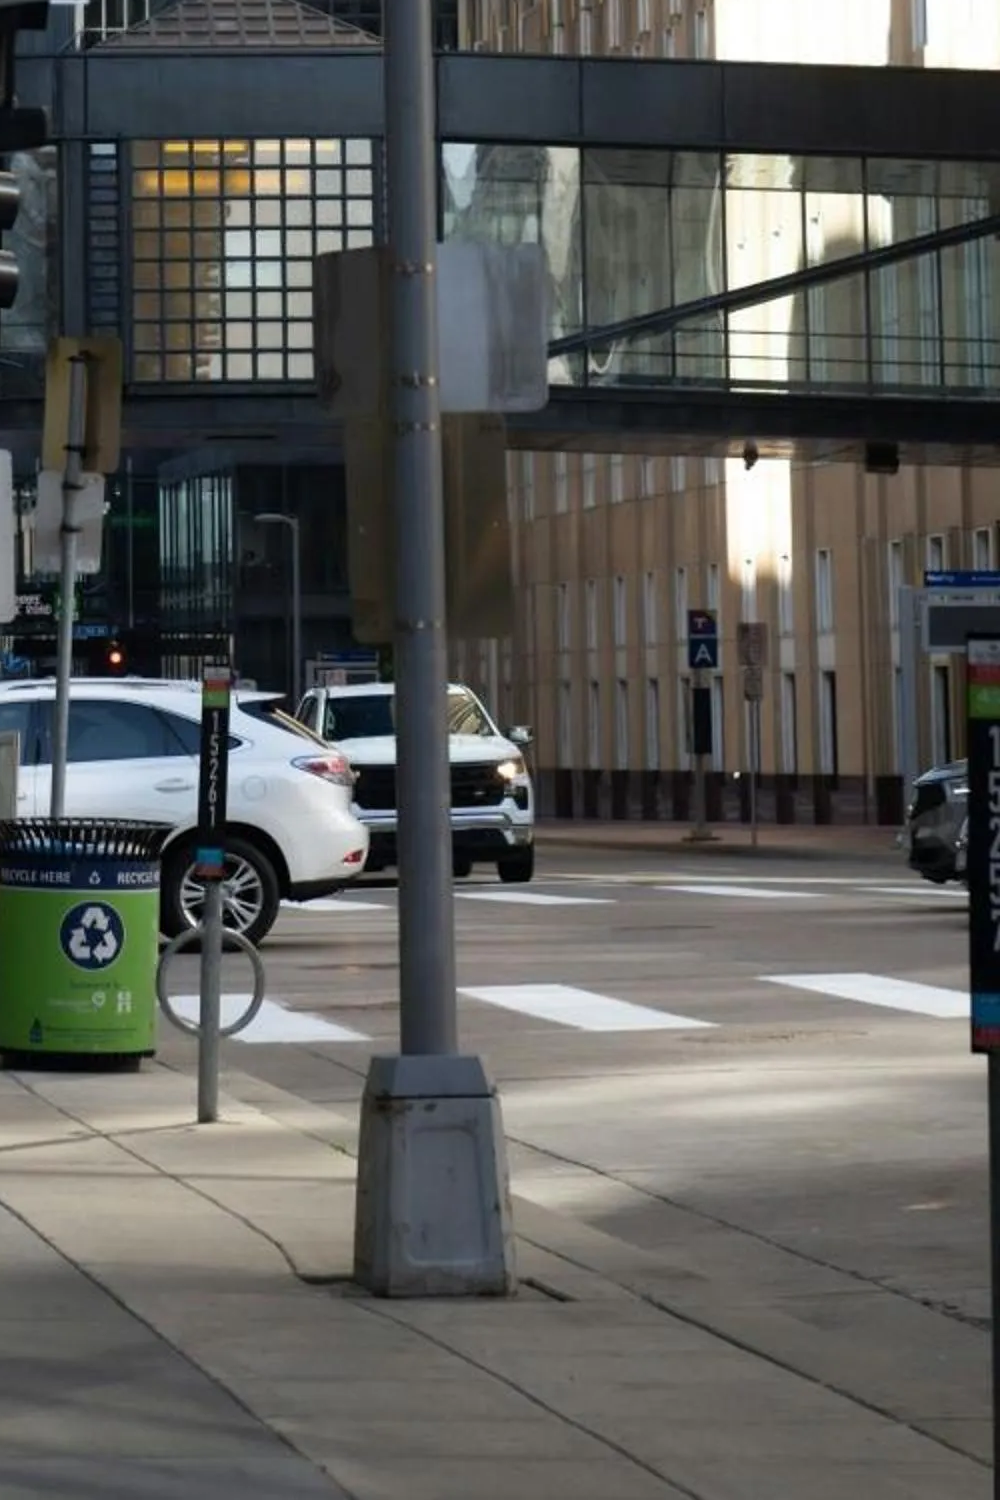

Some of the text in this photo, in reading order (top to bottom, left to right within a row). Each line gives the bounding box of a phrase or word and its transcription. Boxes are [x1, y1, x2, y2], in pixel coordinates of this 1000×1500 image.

[695, 644, 712, 663] A
[208, 710, 220, 828] 15261
[40, 870, 72, 885] HERE
